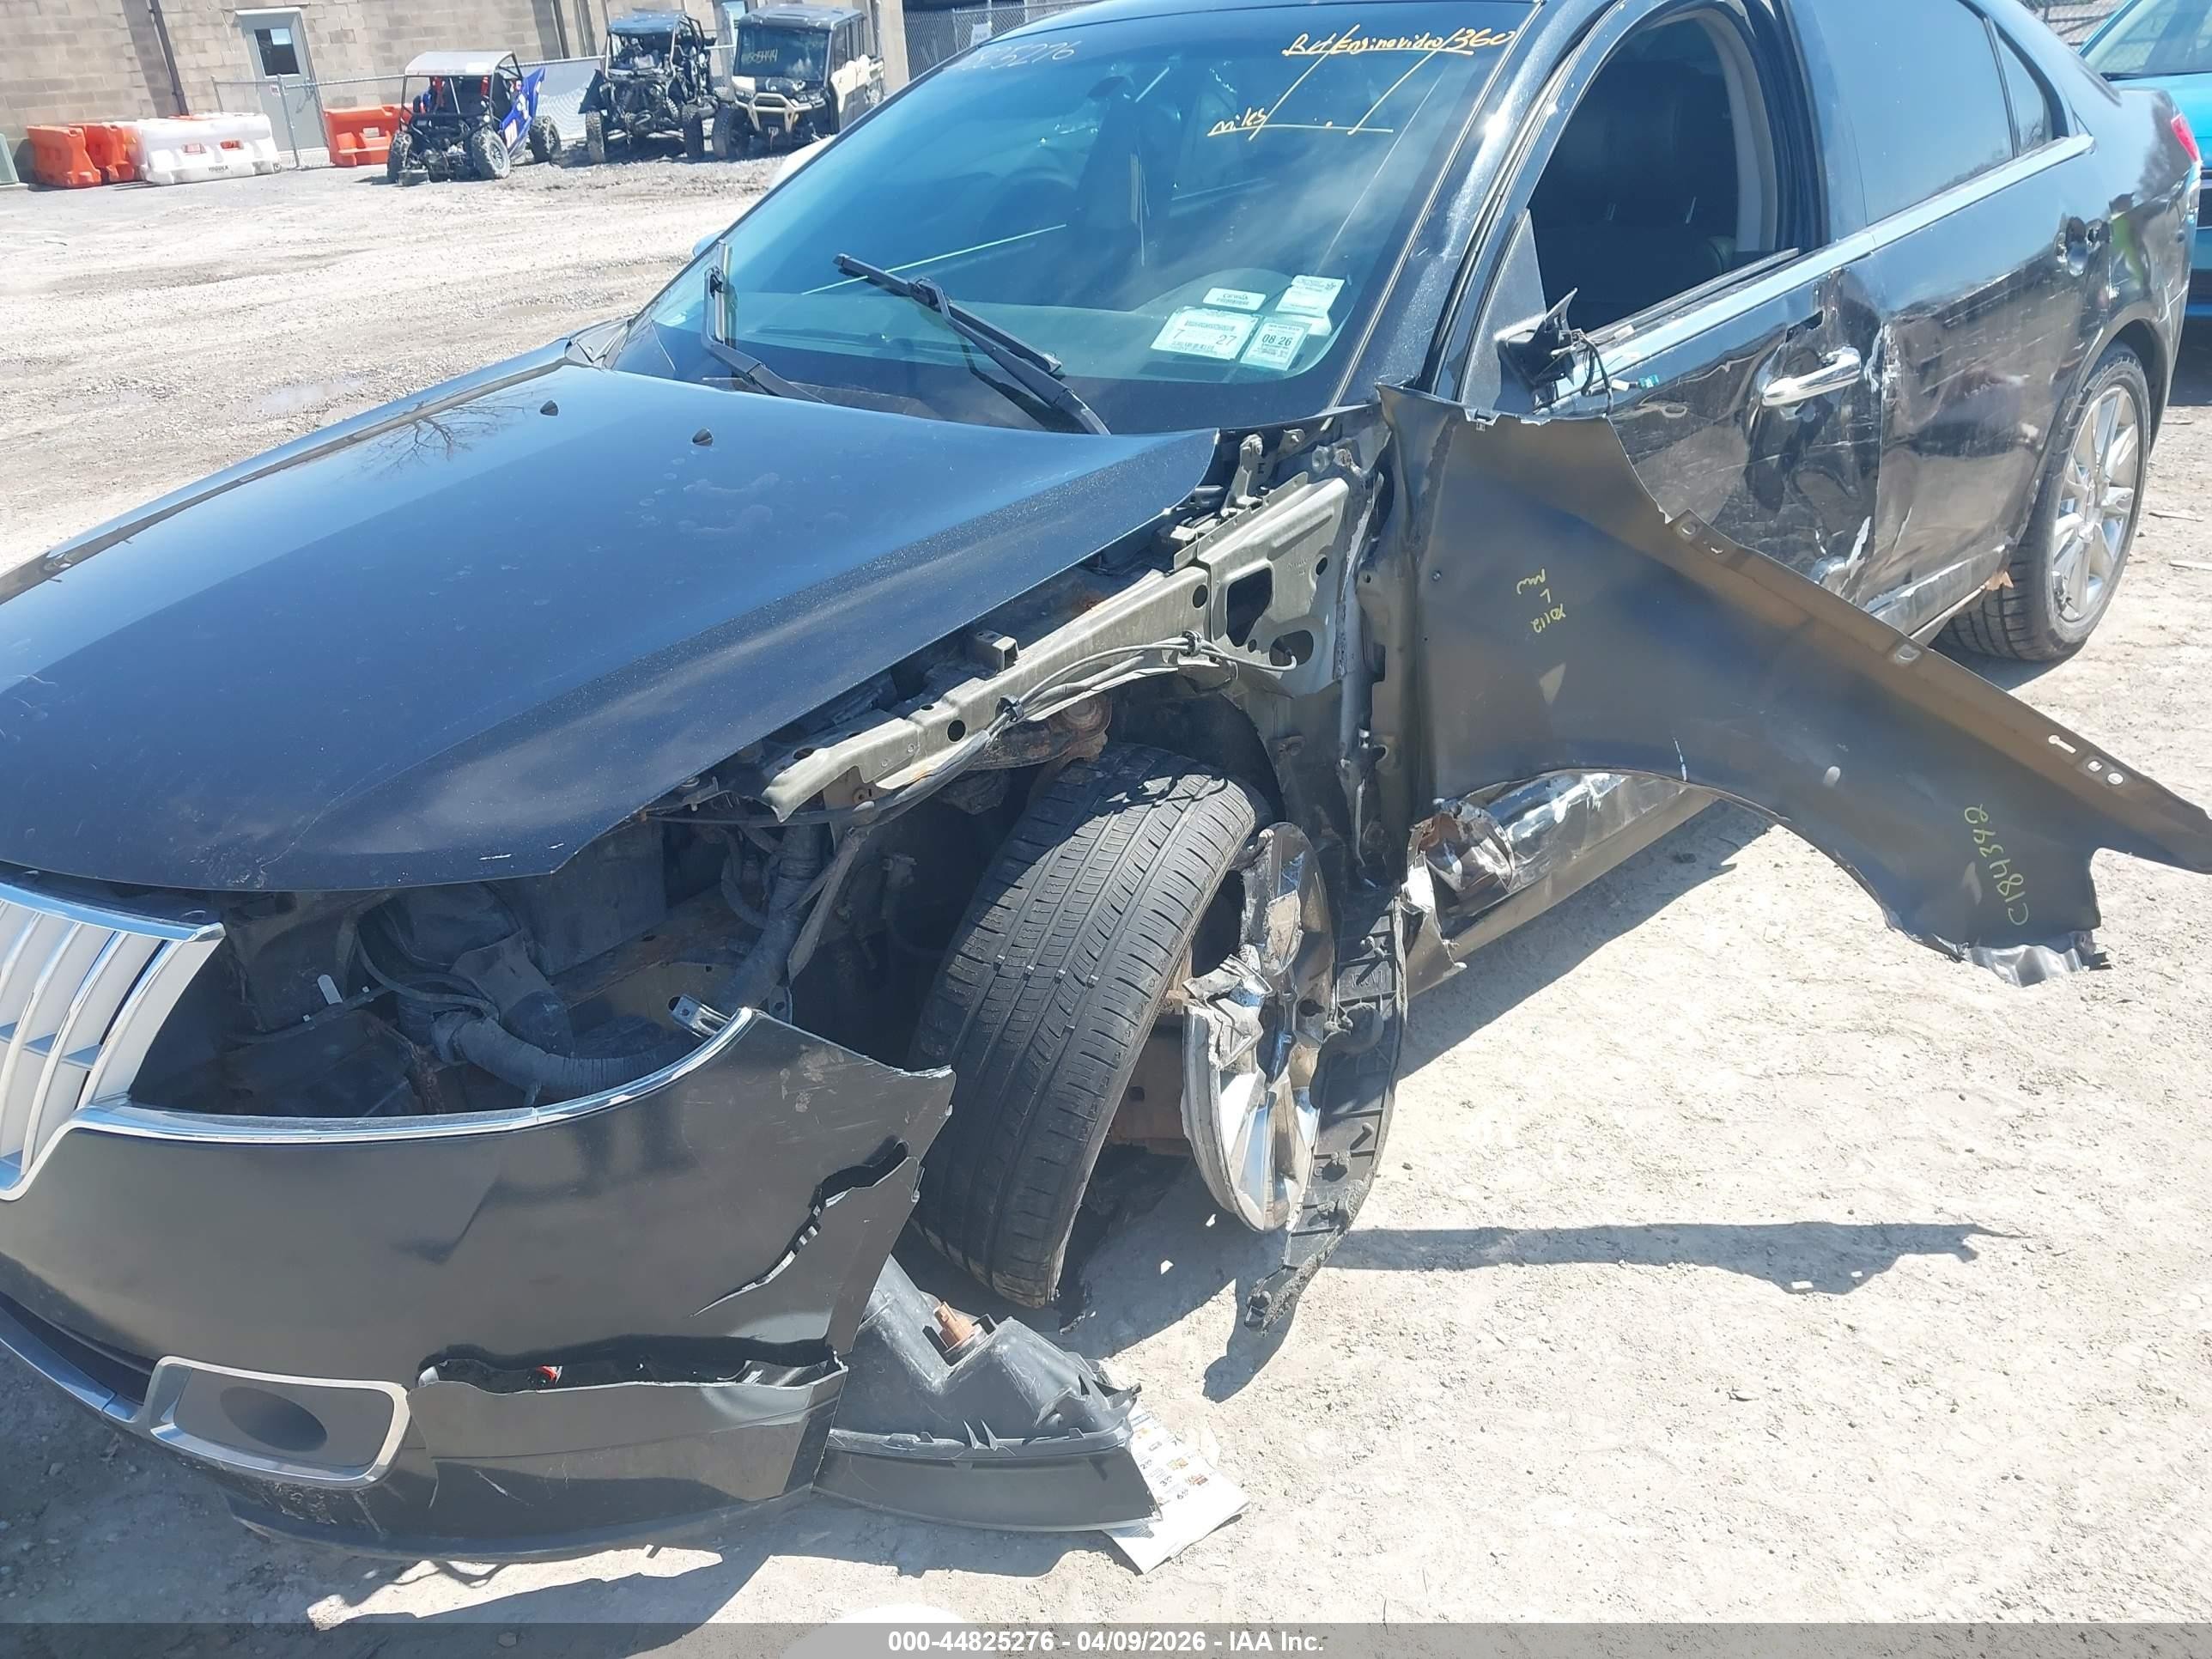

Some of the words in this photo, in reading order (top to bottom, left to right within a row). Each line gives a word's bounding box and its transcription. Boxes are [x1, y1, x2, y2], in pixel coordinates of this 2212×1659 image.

[1216, 334, 1237, 346] 27
[1262, 334, 1277, 344] 08
[1277, 337, 1293, 347] 26
